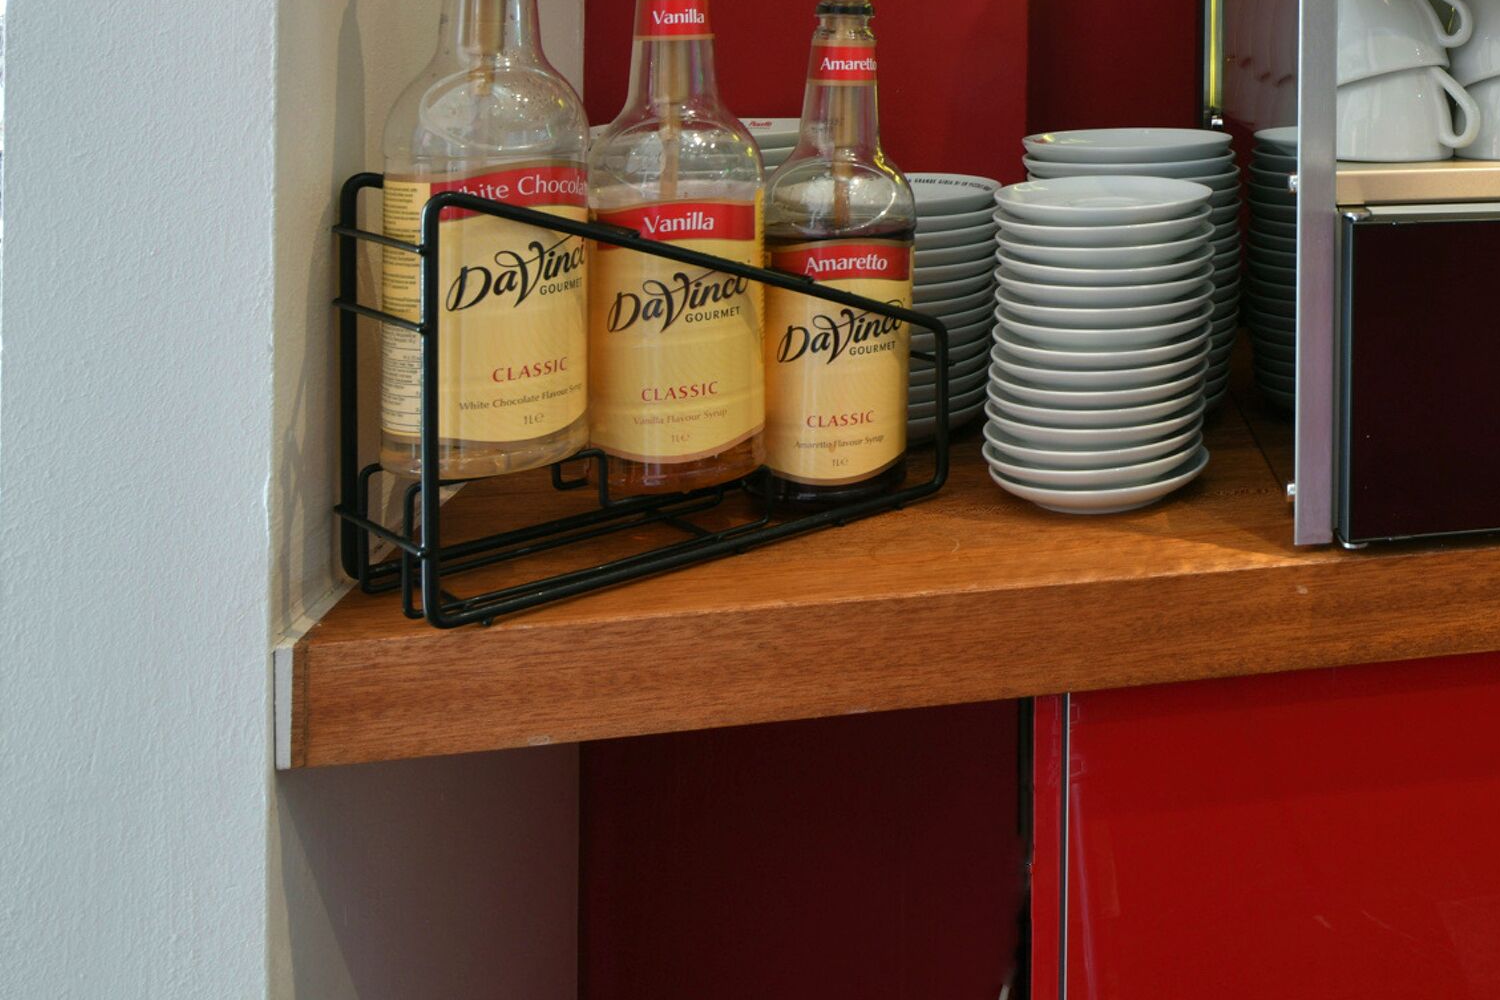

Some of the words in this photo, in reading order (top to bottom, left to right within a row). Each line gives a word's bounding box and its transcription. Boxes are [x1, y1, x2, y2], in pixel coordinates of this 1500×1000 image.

[652, 8, 705, 25] Vanilla
[820, 56, 878, 71] Amaretto
[643, 211, 715, 233] Vanilla
[445, 234, 586, 312] DaVinci
[804, 253, 888, 275] Amaretto
[539, 276, 583, 296] GOURMET
[684, 305, 742, 324] GOURMET
[848, 340, 897, 357] GOURMET
[492, 356, 569, 383] CLASSIC
[641, 380, 719, 402] CLASSIC
[458, 400, 490, 411] White
[492, 394, 541, 409] Chocolate
[633, 415, 664, 425] Vanilla
[666, 412, 702, 424] Flavour
[806, 410, 876, 429] CLASSIC
